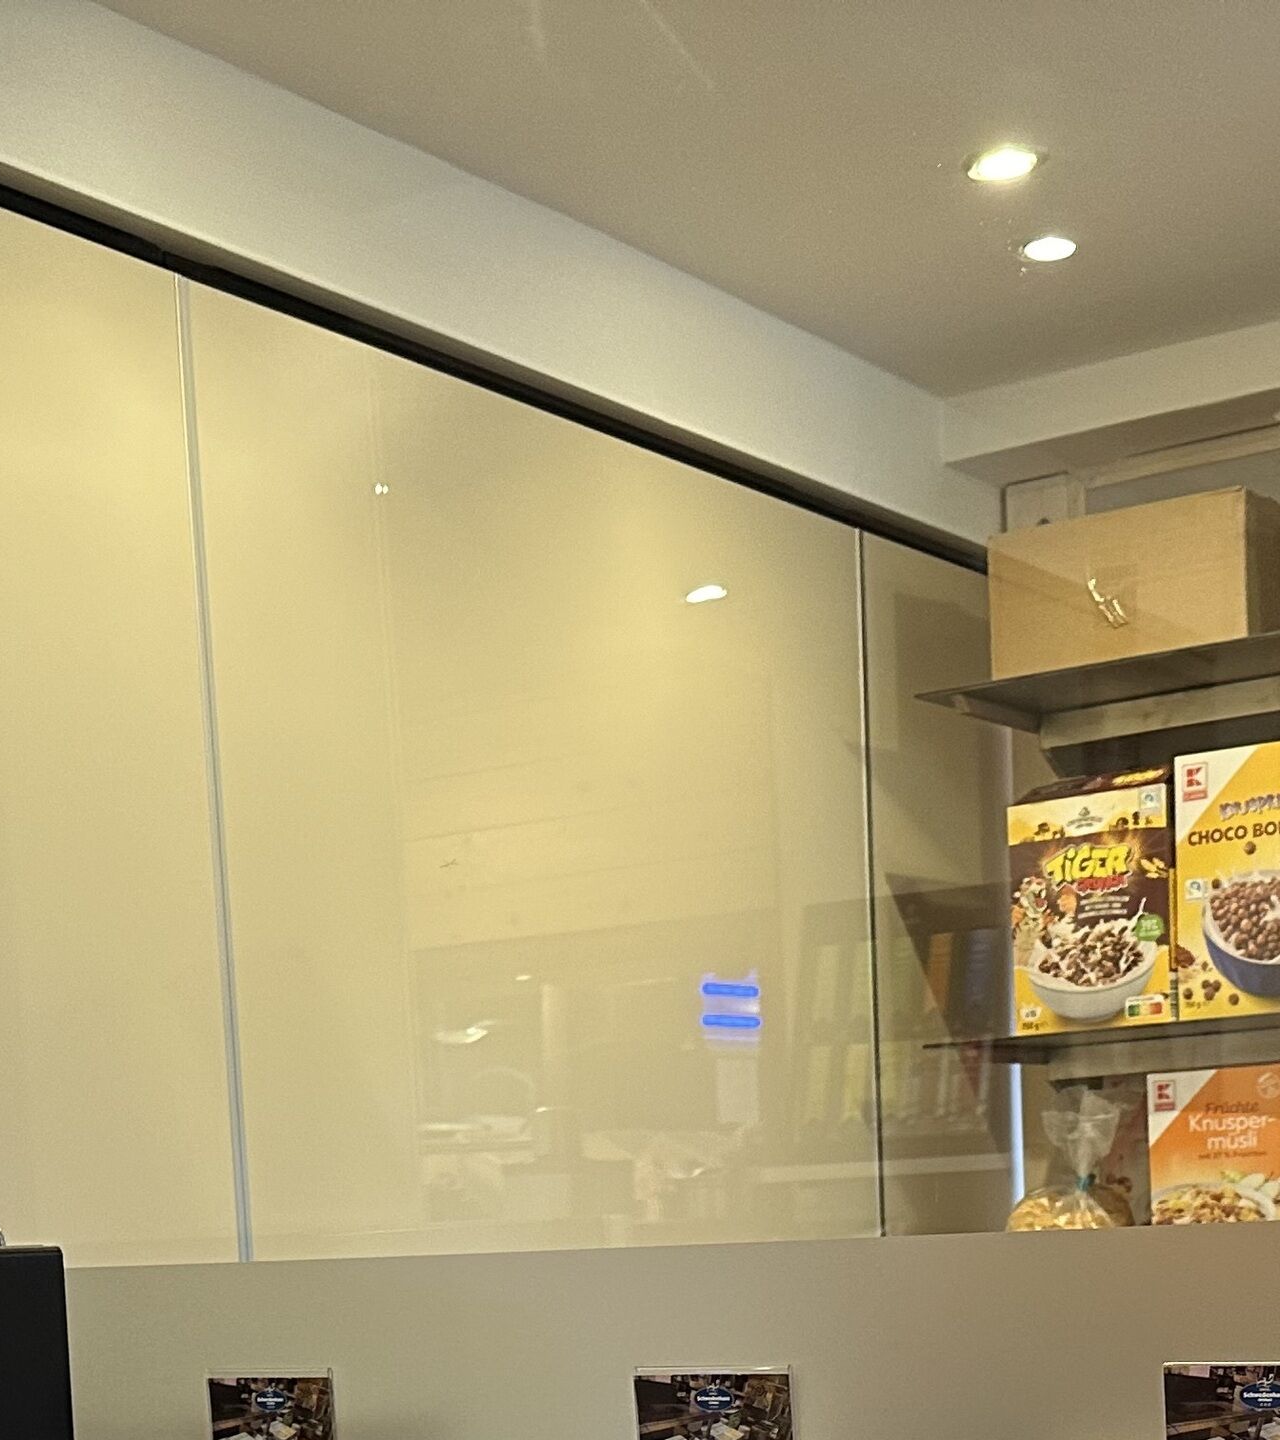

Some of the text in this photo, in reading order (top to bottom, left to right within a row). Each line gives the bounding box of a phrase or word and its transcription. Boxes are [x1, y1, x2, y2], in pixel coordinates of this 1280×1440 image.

[1188, 824, 1248, 846] CHOCO
[1188, 1113, 1277, 1134] Knusper-
[1206, 1131, 1258, 1152] müsli
